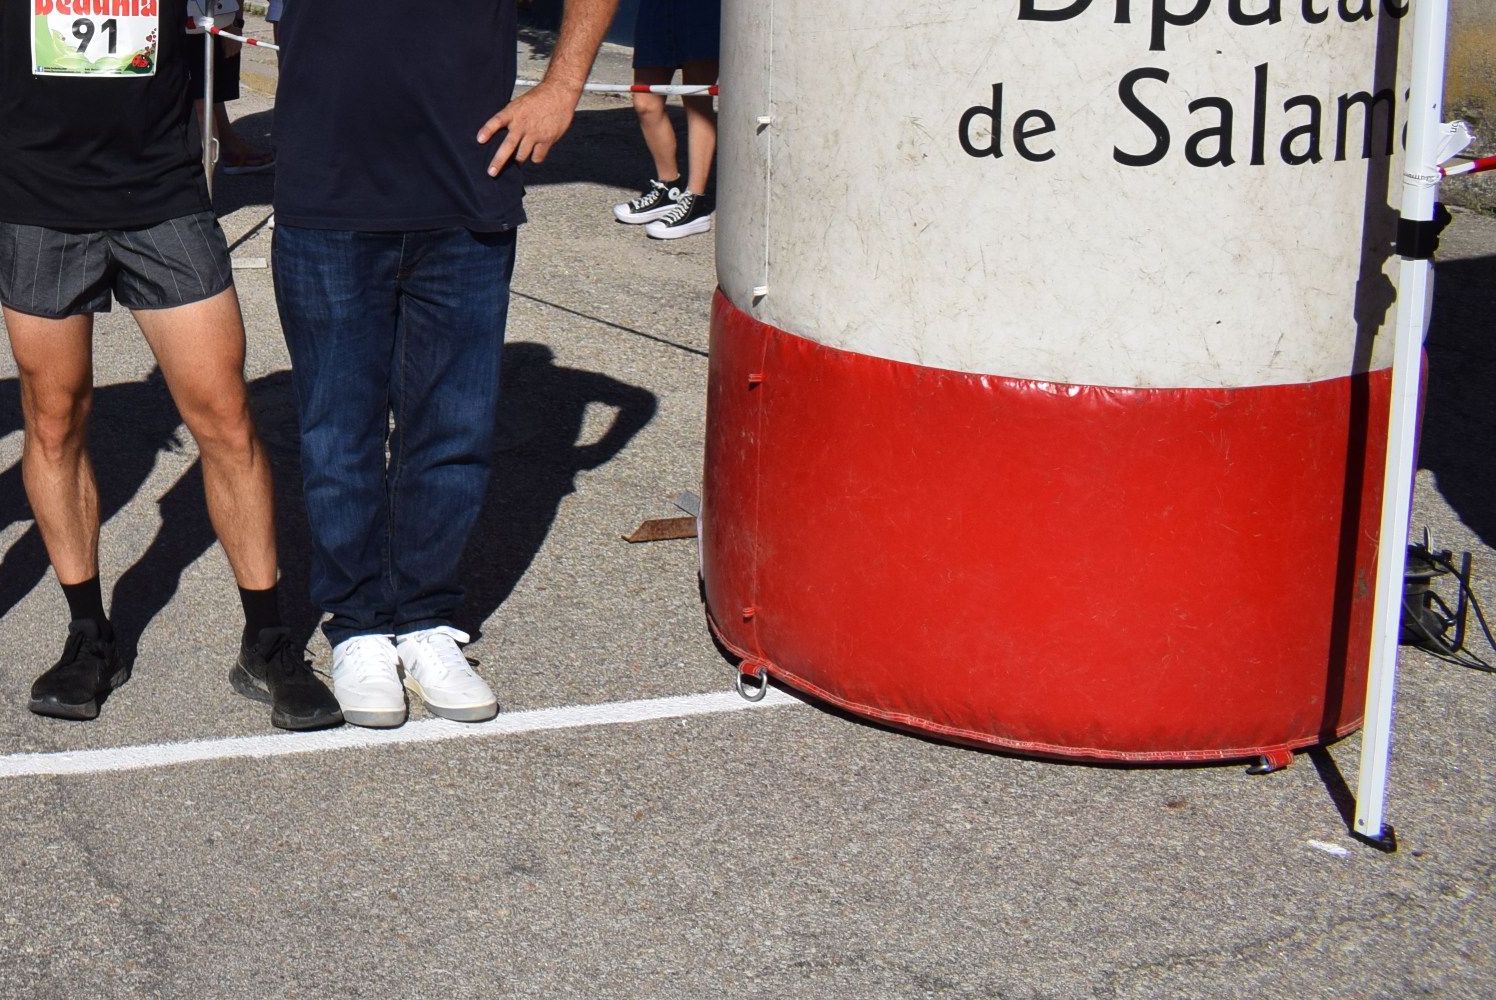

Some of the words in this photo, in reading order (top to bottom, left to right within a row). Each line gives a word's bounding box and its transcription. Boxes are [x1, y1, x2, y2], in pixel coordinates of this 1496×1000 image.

[71, 17, 118, 54] 91
[957, 82, 1056, 162] de
[1112, 62, 1411, 168] Salam
